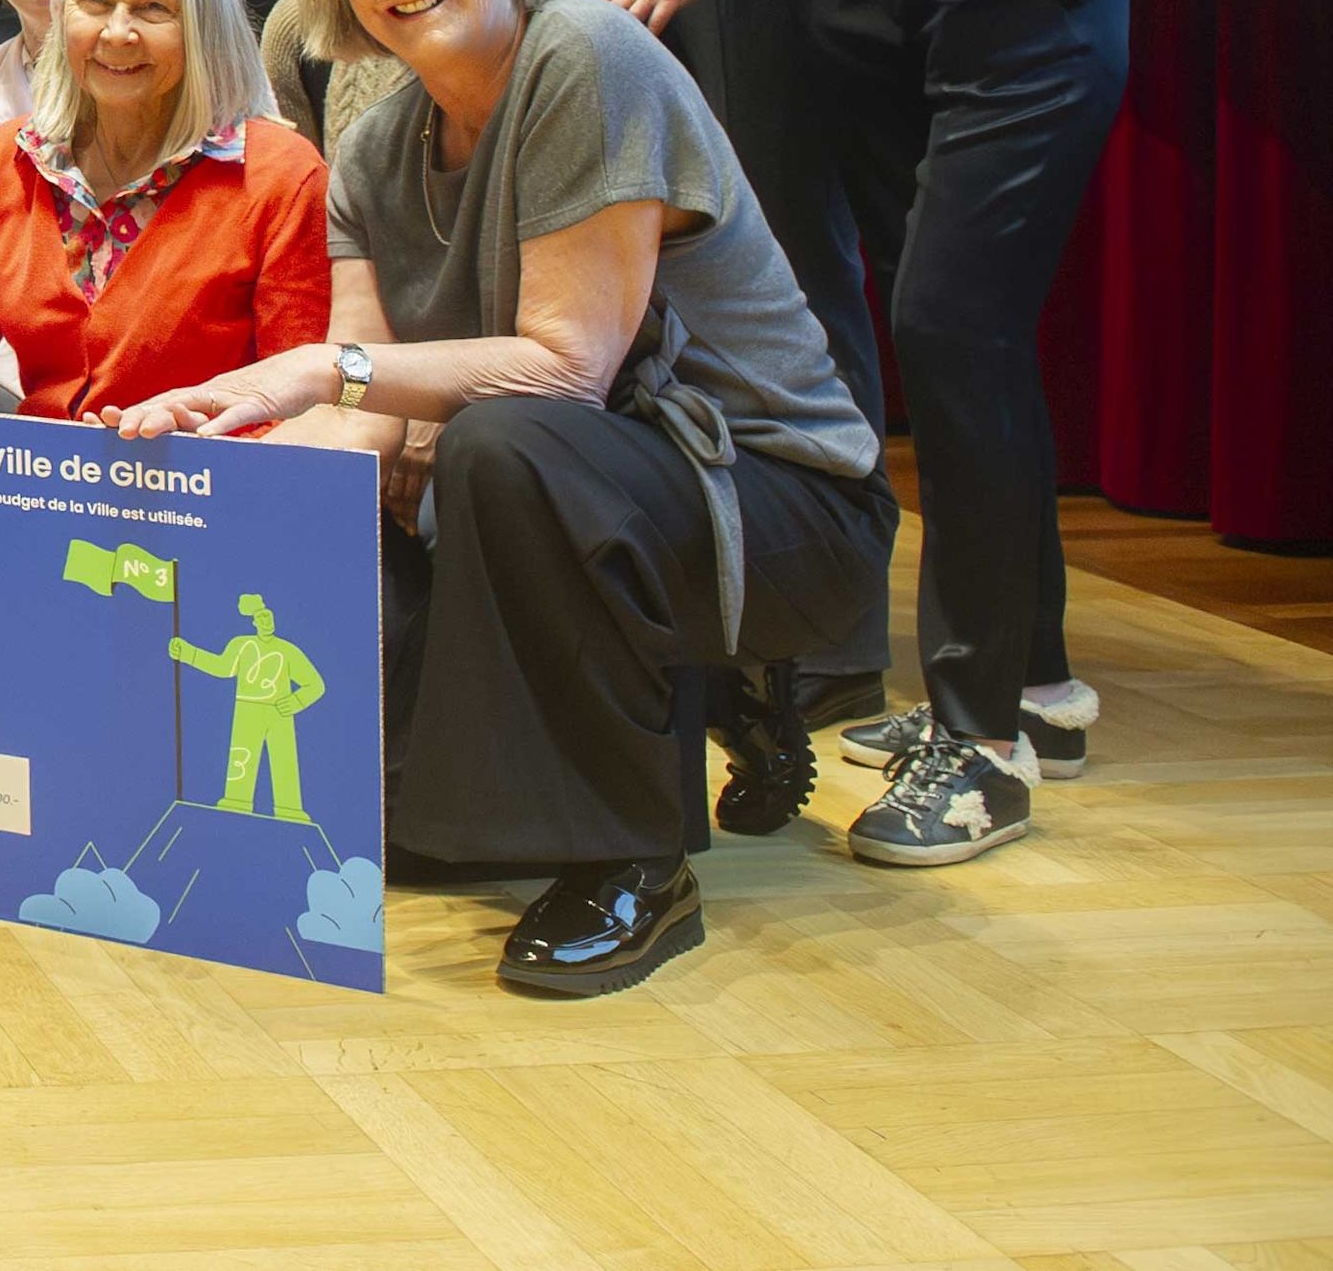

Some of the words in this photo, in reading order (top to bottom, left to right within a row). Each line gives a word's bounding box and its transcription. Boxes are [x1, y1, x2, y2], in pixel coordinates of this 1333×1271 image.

[59, 453, 102, 483] de
[108, 459, 211, 496] Gland
[46, 497, 67, 511] de
[68, 499, 84, 513] la
[85, 501, 119, 518] Ville
[120, 507, 145, 521] est
[147, 509, 207, 528] utilisée.
